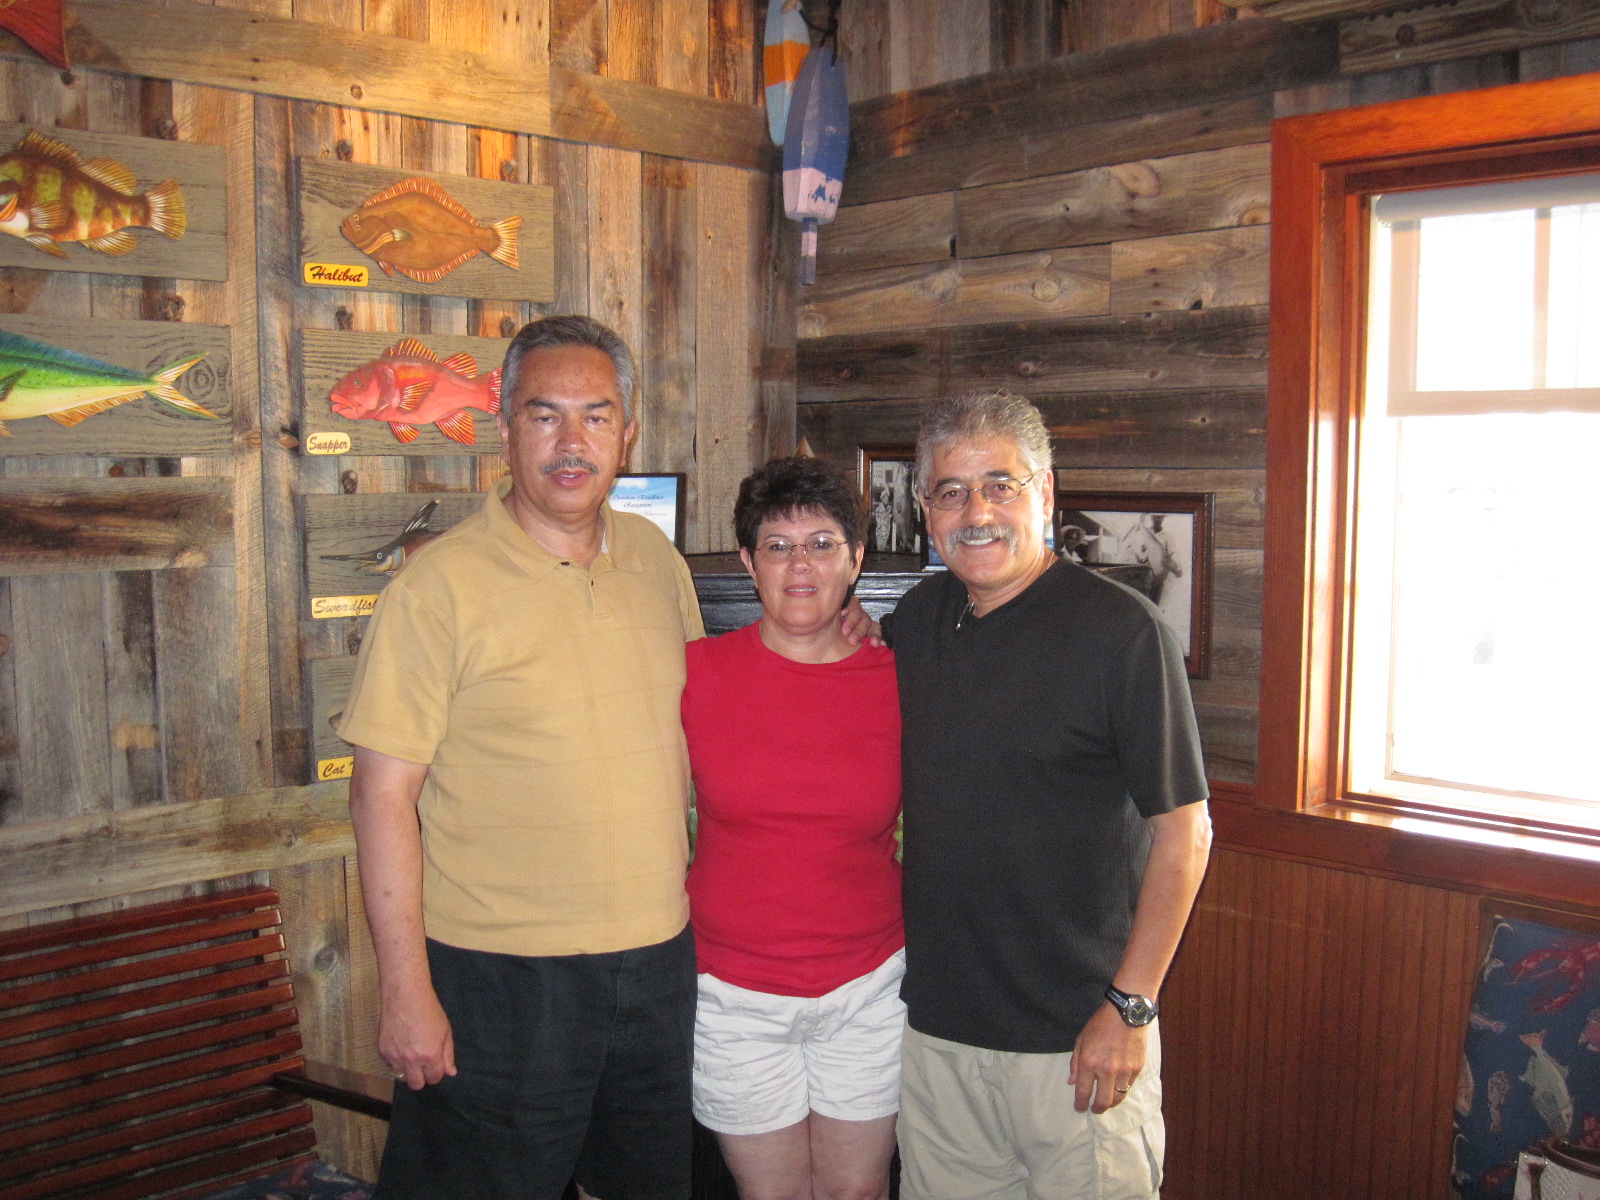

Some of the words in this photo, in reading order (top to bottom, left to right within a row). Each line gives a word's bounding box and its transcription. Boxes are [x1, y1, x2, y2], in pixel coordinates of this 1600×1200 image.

[309, 265, 364, 283] Halibut
[308, 435, 349, 453] Snapper
[322, 762, 346, 778] Cat
